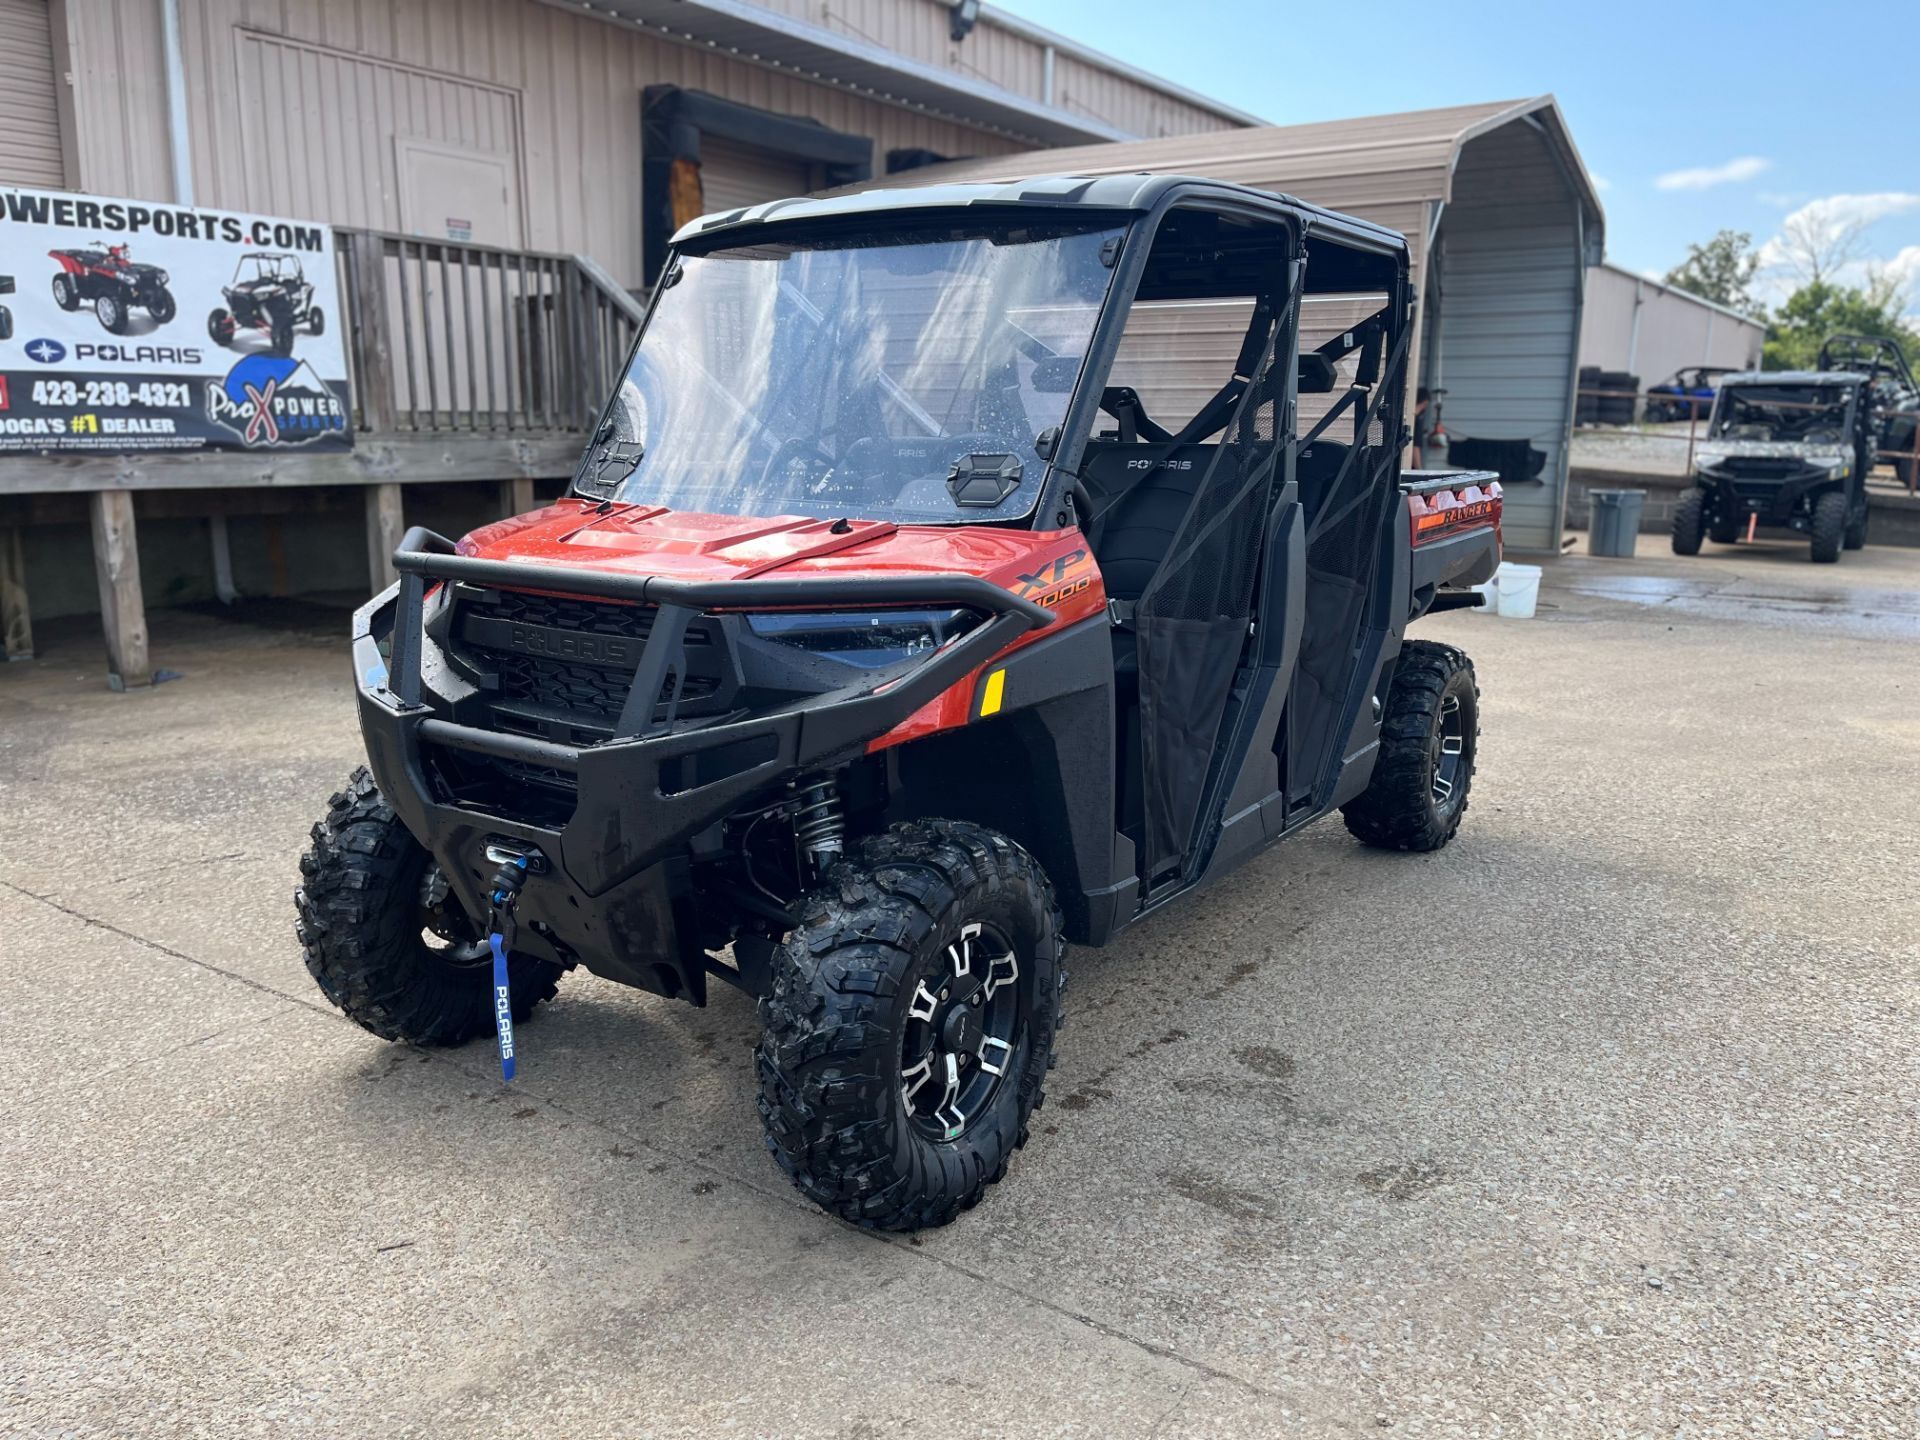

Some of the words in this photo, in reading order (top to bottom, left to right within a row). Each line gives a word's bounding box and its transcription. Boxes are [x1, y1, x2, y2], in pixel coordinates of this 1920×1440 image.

[0, 192, 323, 252] WERSPORTS.COM
[75, 344, 202, 364] POLARIS
[32, 380, 191, 407] 423-238-4321
[274, 397, 340, 416] POWER
[70, 413, 98, 434] #1
[102, 418, 177, 434] DEALER
[276, 415, 343, 431] SPORTS
[1127, 459, 1193, 471] POARIS
[1444, 502, 1488, 523] RANGER
[1015, 549, 1087, 598] XP
[511, 630, 626, 663] POLARIS
[497, 986, 513, 1060] POLARIS
